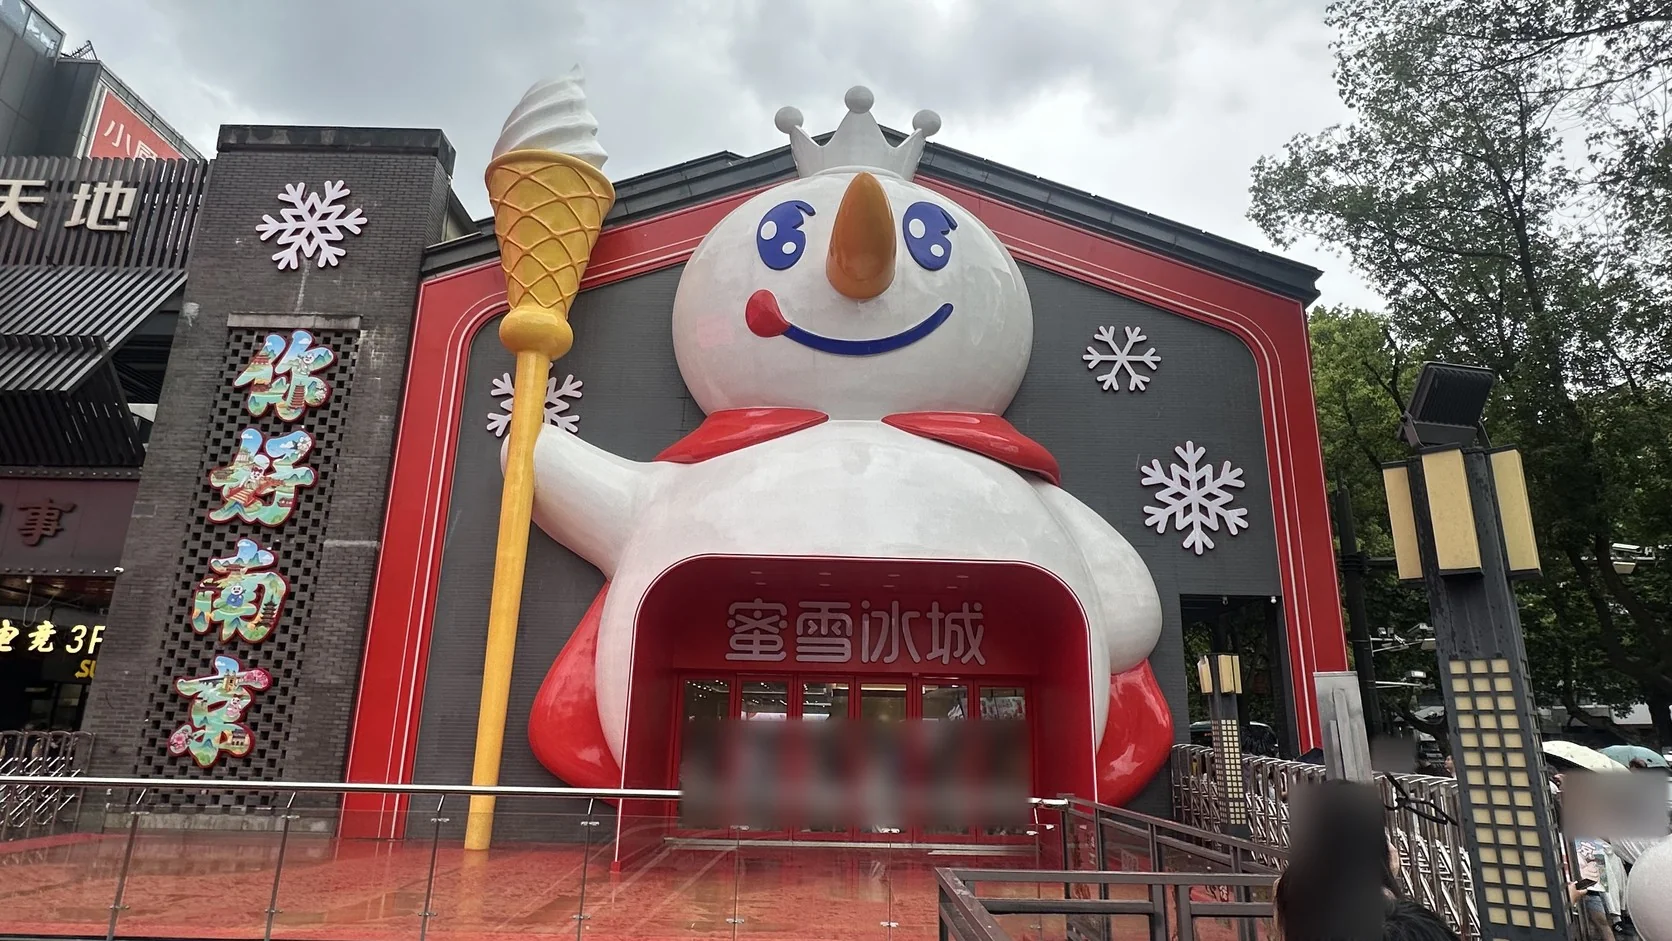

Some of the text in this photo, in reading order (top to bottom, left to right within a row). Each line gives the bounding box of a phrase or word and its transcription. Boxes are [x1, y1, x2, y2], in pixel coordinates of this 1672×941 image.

[0, 179, 138, 231] 天地
[168, 329, 338, 768] 你好南京
[65, 624, 106, 654] 3F
[725, 597, 986, 665] 蜜雪冰城
